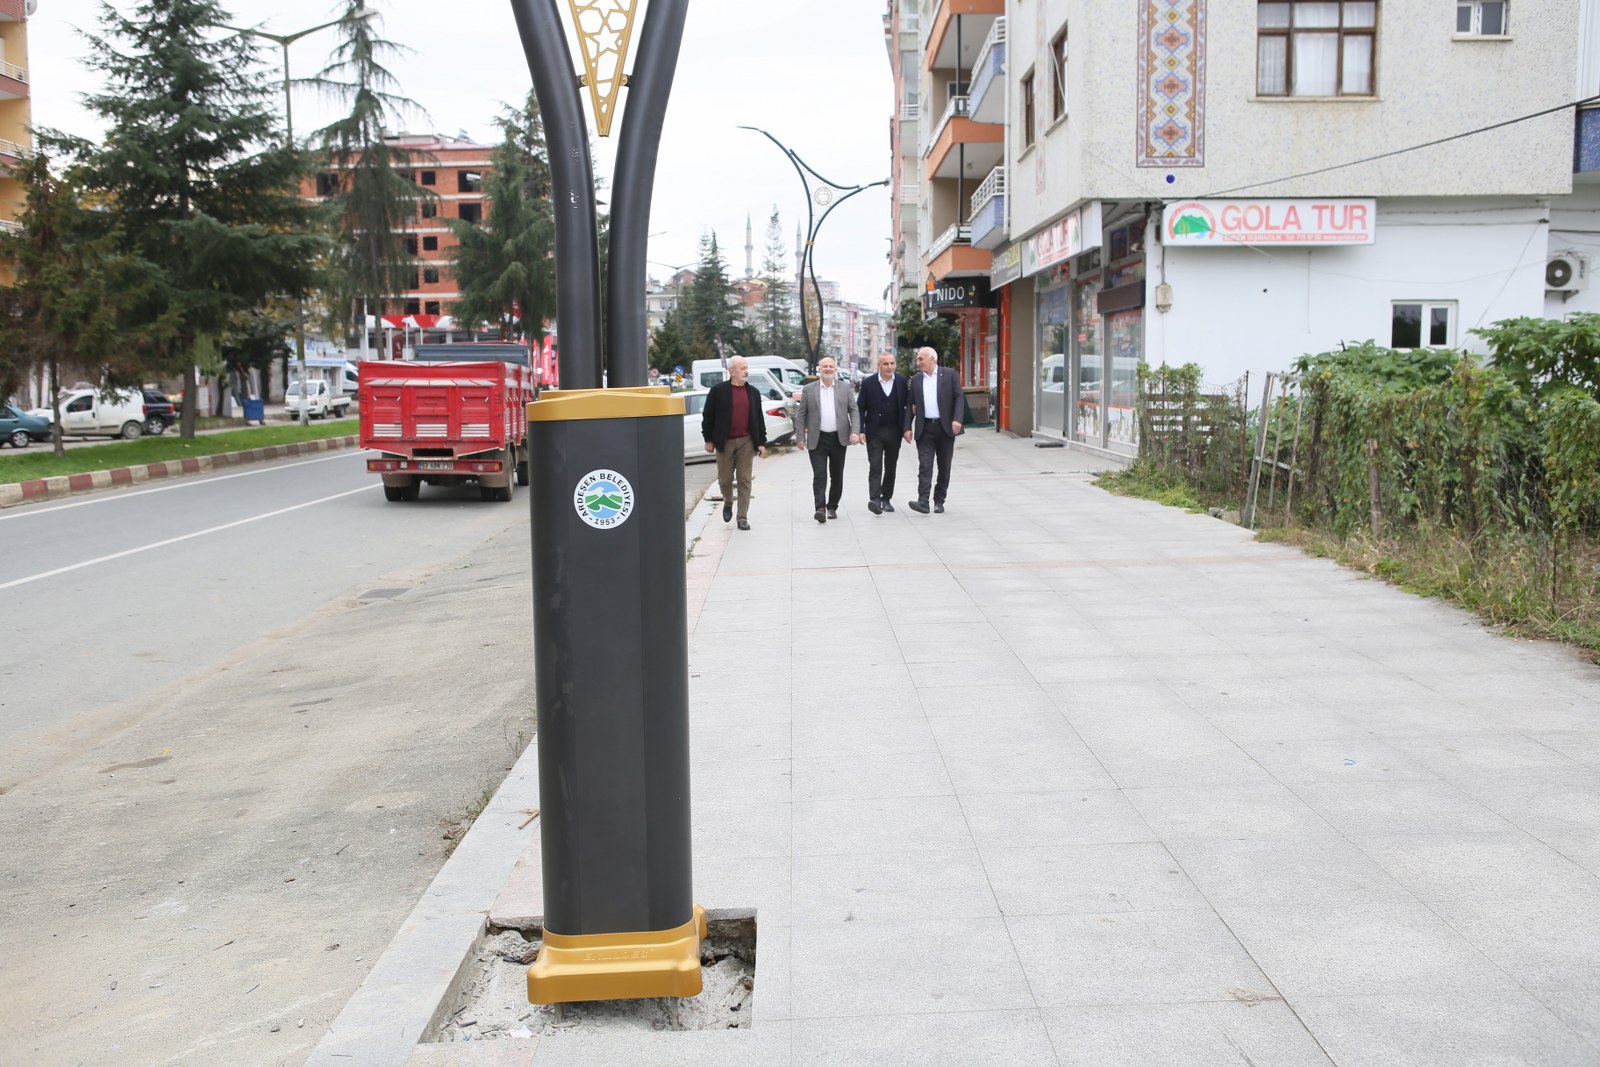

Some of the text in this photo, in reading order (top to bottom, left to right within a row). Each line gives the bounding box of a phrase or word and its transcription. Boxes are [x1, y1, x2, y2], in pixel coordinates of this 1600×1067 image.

[1221, 204, 1368, 231] GOLA TUR
[936, 284, 965, 302] NİDO
[577, 475, 596, 517] ARDEŞEN
[594, 517, 616, 526] 1953
